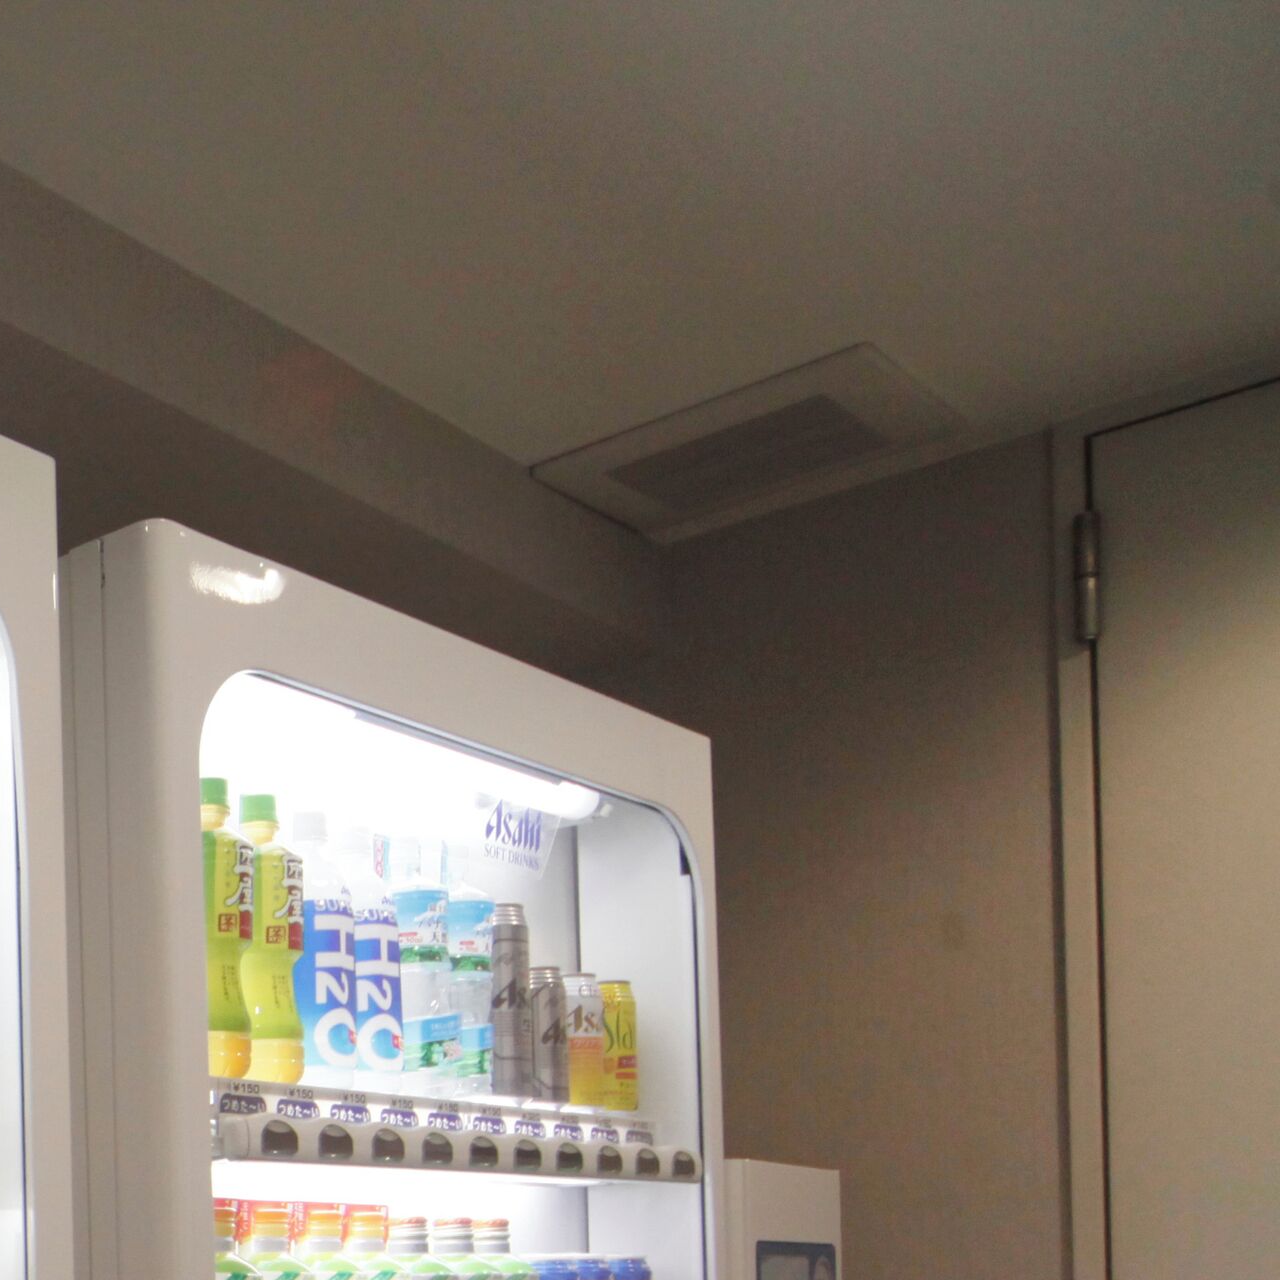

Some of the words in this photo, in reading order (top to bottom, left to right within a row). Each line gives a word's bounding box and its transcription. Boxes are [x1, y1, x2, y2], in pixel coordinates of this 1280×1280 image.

[485, 799, 541, 853] Asahi
[484, 843, 505, 861] SOFT
[508, 850, 539, 871] DRINKS
[232, 1083, 259, 1094] ¥150
[289, 1088, 314, 1099] ¥150
[342, 1094, 365, 1104] ¥150
